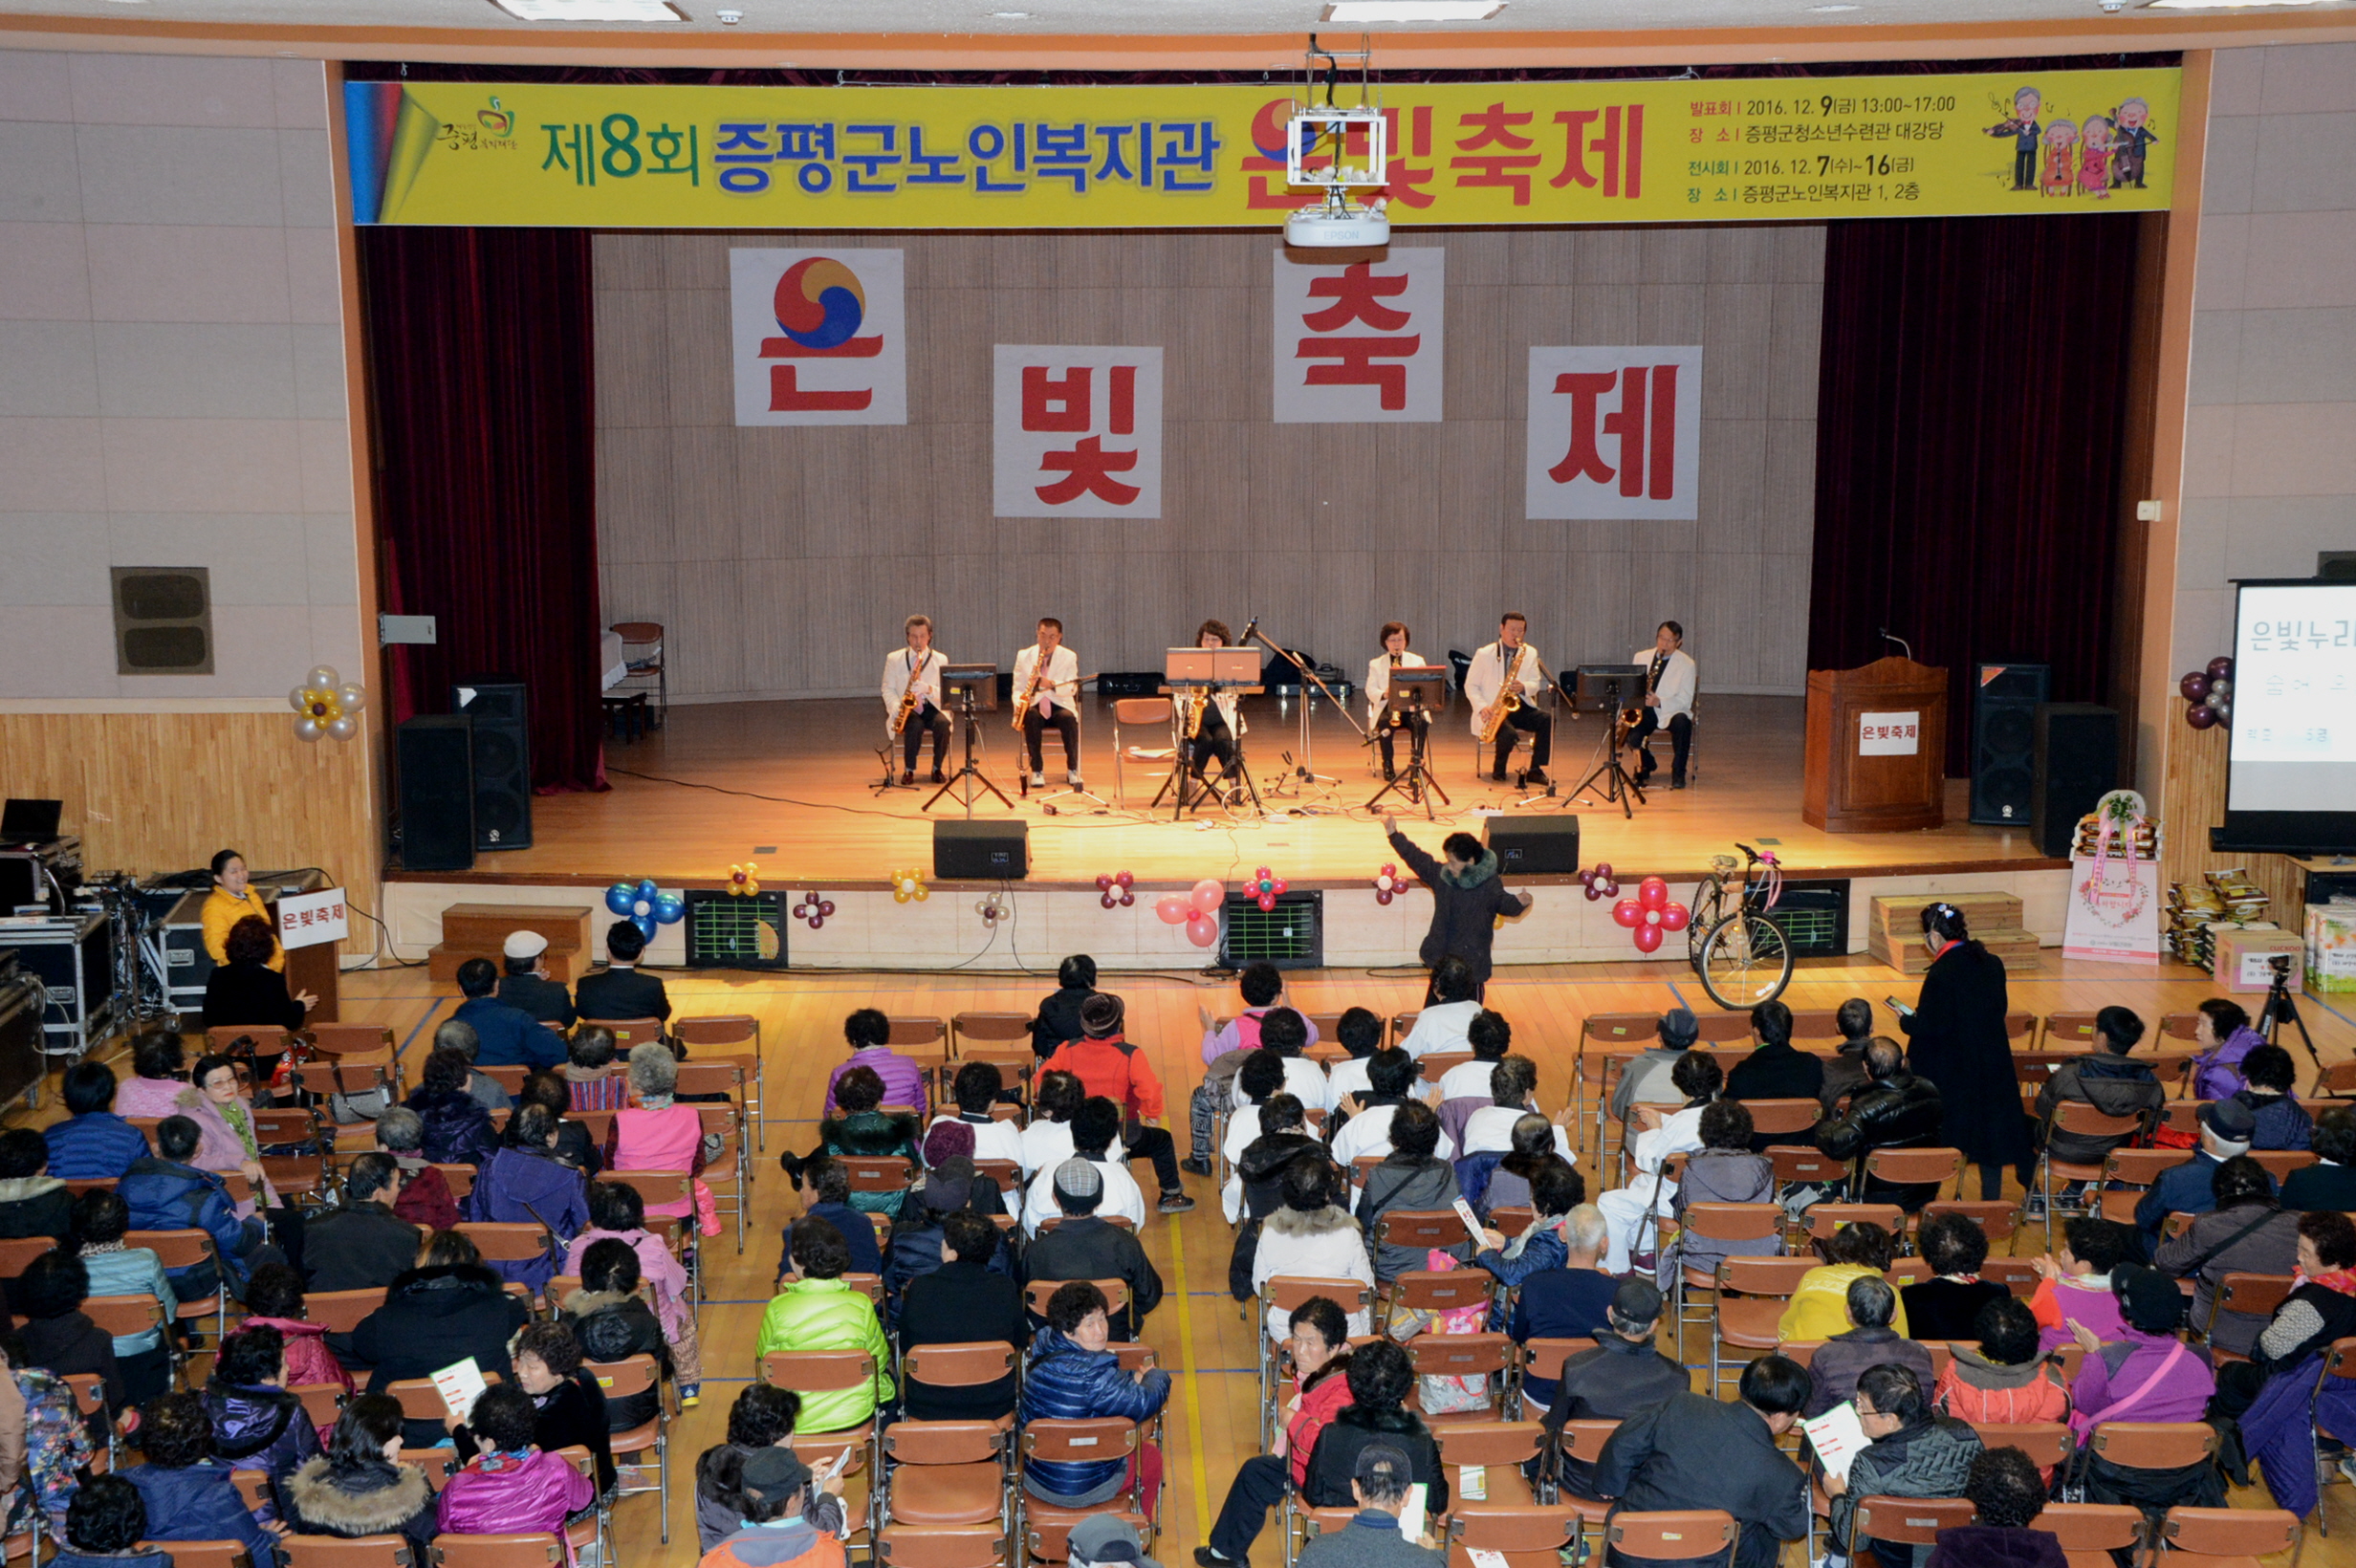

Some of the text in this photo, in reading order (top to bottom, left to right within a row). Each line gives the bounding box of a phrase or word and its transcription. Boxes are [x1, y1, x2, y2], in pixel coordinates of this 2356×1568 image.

[1690, 99, 1733, 117] 발표회
[1746, 99, 1788, 116] 2016.
[1793, 98, 1815, 116] 12.
[1863, 96, 1955, 113] 13:00~17:00
[1745, 122, 1891, 143] 증평군청소년수련관
[1896, 121, 1945, 141] 대강당
[540, 112, 701, 188] 제8회
[713, 120, 1221, 192] 증평군노인복지관
[1688, 160, 1729, 176] 전시회
[1743, 160, 1784, 176] 2016.
[1791, 159, 1812, 175] 12.
[1742, 184, 1872, 204] 증평군노인복지관
[1894, 182, 1920, 201] 2층
[1323, 230, 1360, 240] EPSON
[757, 256, 884, 412] 은
[1294, 258, 1421, 410] 축
[1021, 365, 1142, 506] 빛
[1547, 364, 1680, 500] 제
[1862, 724, 1916, 740] 은빛축제
[282, 903, 345, 930] 은빛축제
